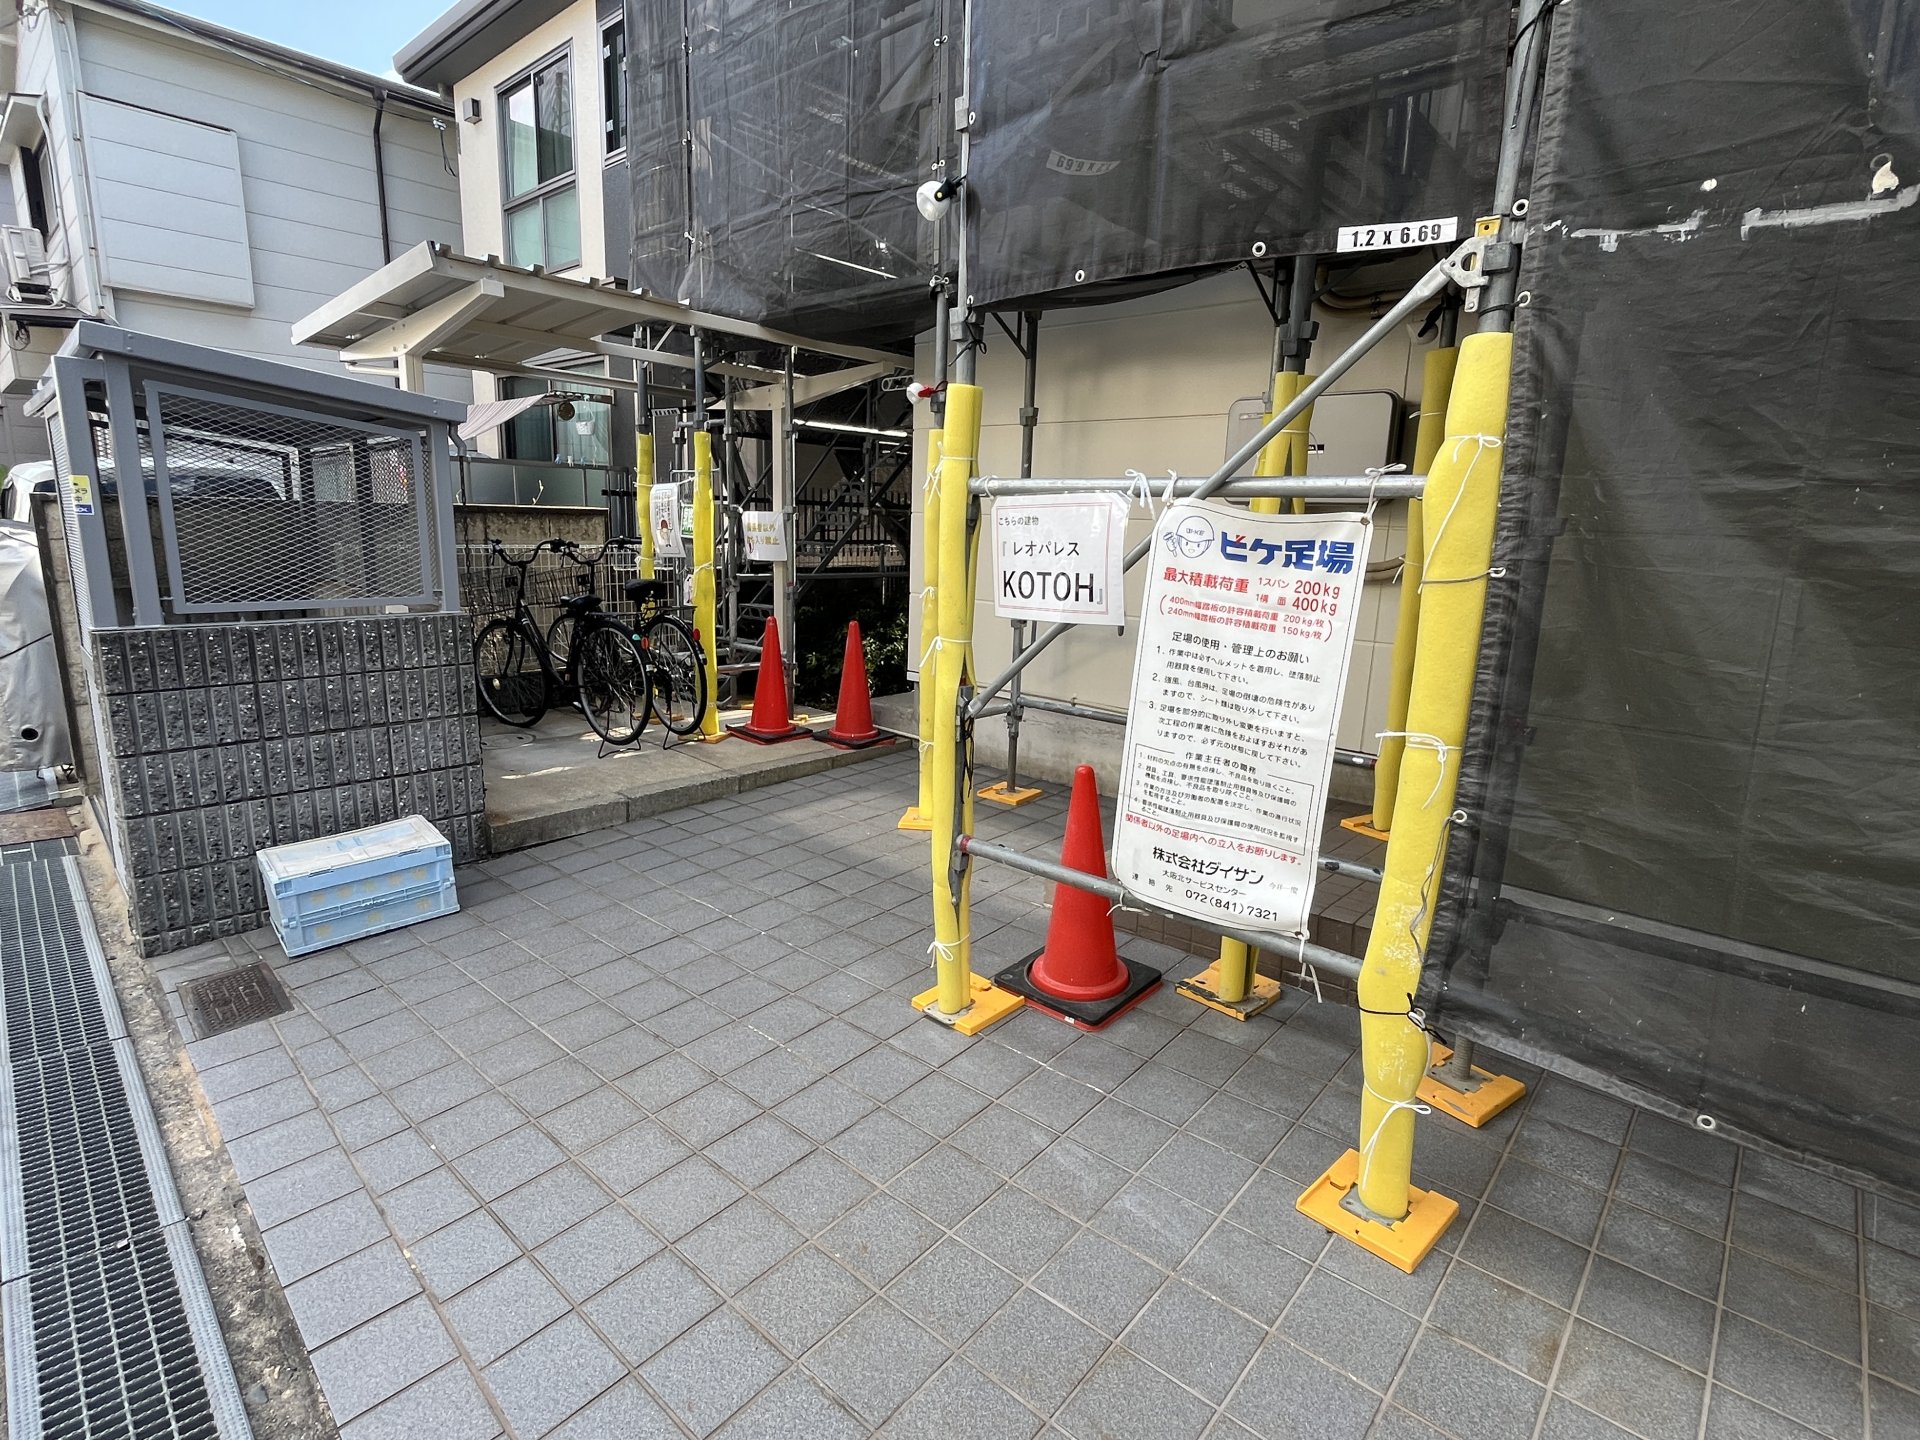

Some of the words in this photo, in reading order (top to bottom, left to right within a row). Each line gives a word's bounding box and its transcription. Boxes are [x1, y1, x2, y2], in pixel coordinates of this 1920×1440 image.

[1351, 229, 1376, 247] 1.2
[1400, 223, 1441, 244] 6.69
[998, 516, 1039, 526] こちらの建物
[1221, 531, 1355, 575] ビケ足場
[1163, 567, 1249, 594] 最大積載荷重
[1258, 577, 1290, 590] 1スパン
[1172, 631, 1310, 664] 足場の使用・管理上のお願い
[1152, 846, 1264, 885] 株式会社ダイサン
[1162, 869, 1247, 896] 大阪北サービスセンター
[1185, 888, 1278, 922] 072(841)7321
